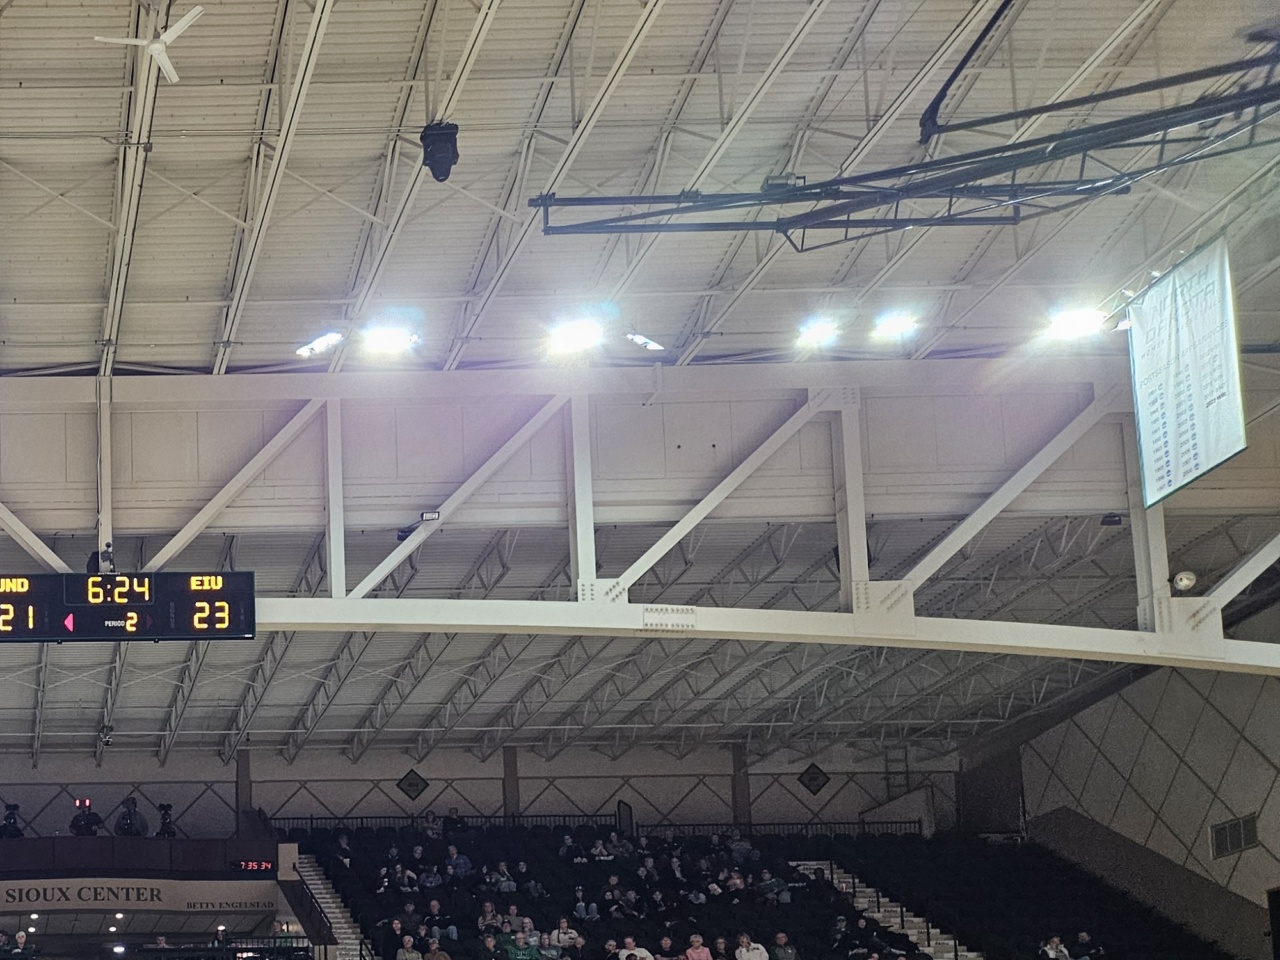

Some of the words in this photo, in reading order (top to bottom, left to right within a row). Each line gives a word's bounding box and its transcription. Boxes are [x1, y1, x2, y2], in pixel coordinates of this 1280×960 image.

[88, 576, 149, 604] 6:24
[191, 576, 223, 590] EIU
[126, 612, 138, 632] 2
[194, 602, 229, 628] 23
[5, 887, 70, 903] SIOUX
[77, 886, 163, 902] CENTER
